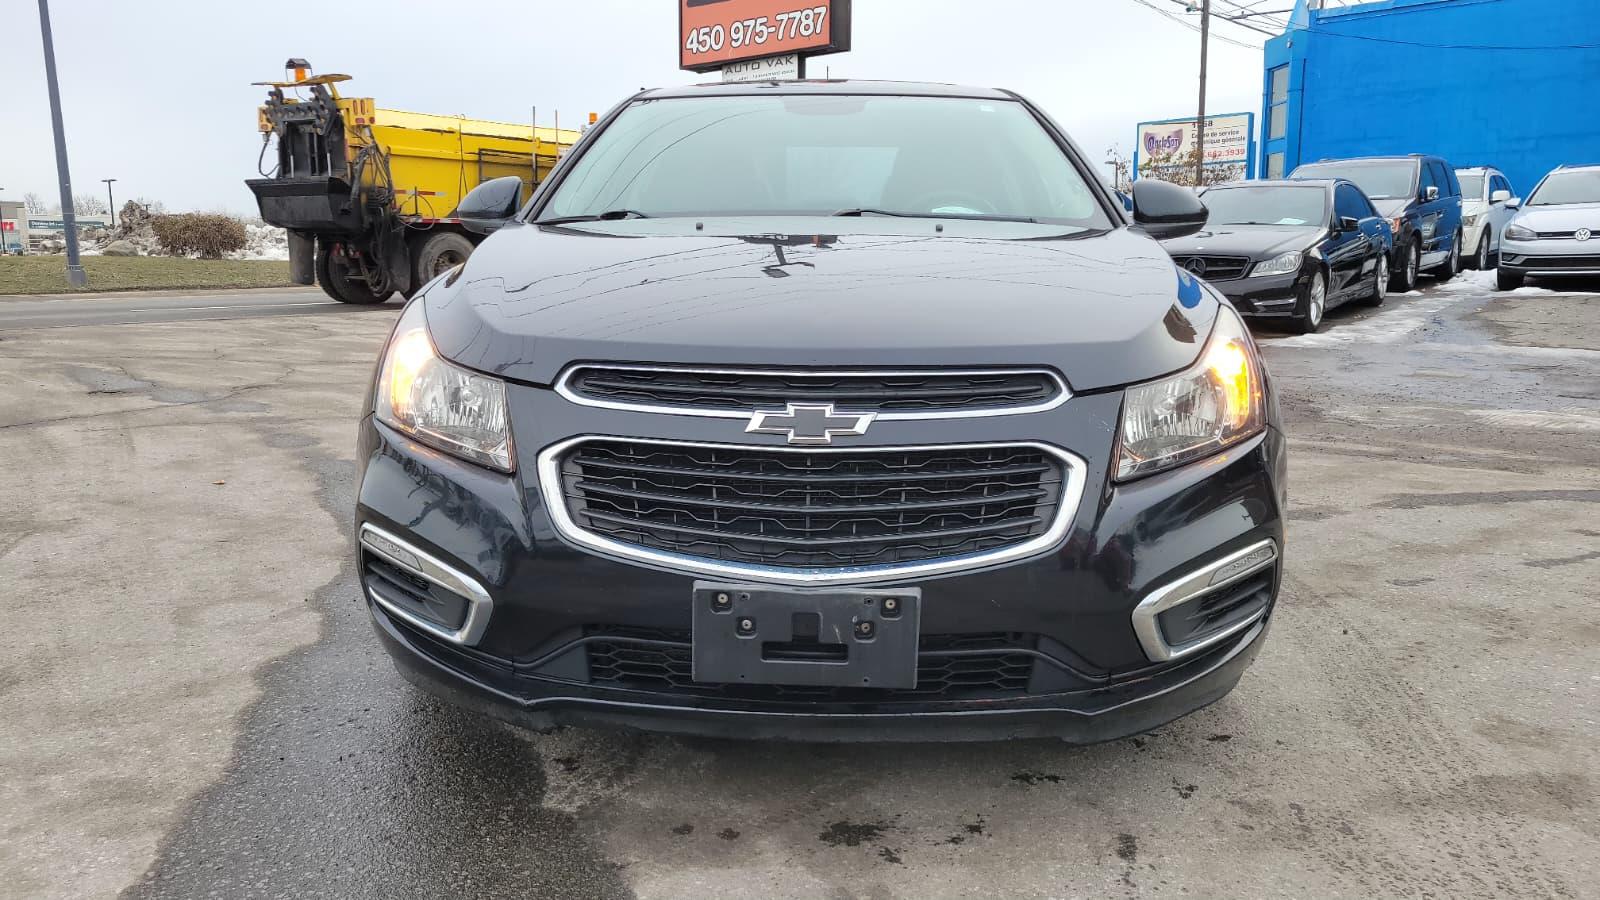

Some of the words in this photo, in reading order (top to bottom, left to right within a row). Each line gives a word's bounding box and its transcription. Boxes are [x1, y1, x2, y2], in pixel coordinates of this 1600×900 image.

[685, 24, 725, 54] 450
[730, 6, 827, 49] 975-7787
[725, 61, 760, 75] AUTO
[766, 55, 794, 67] VAK
